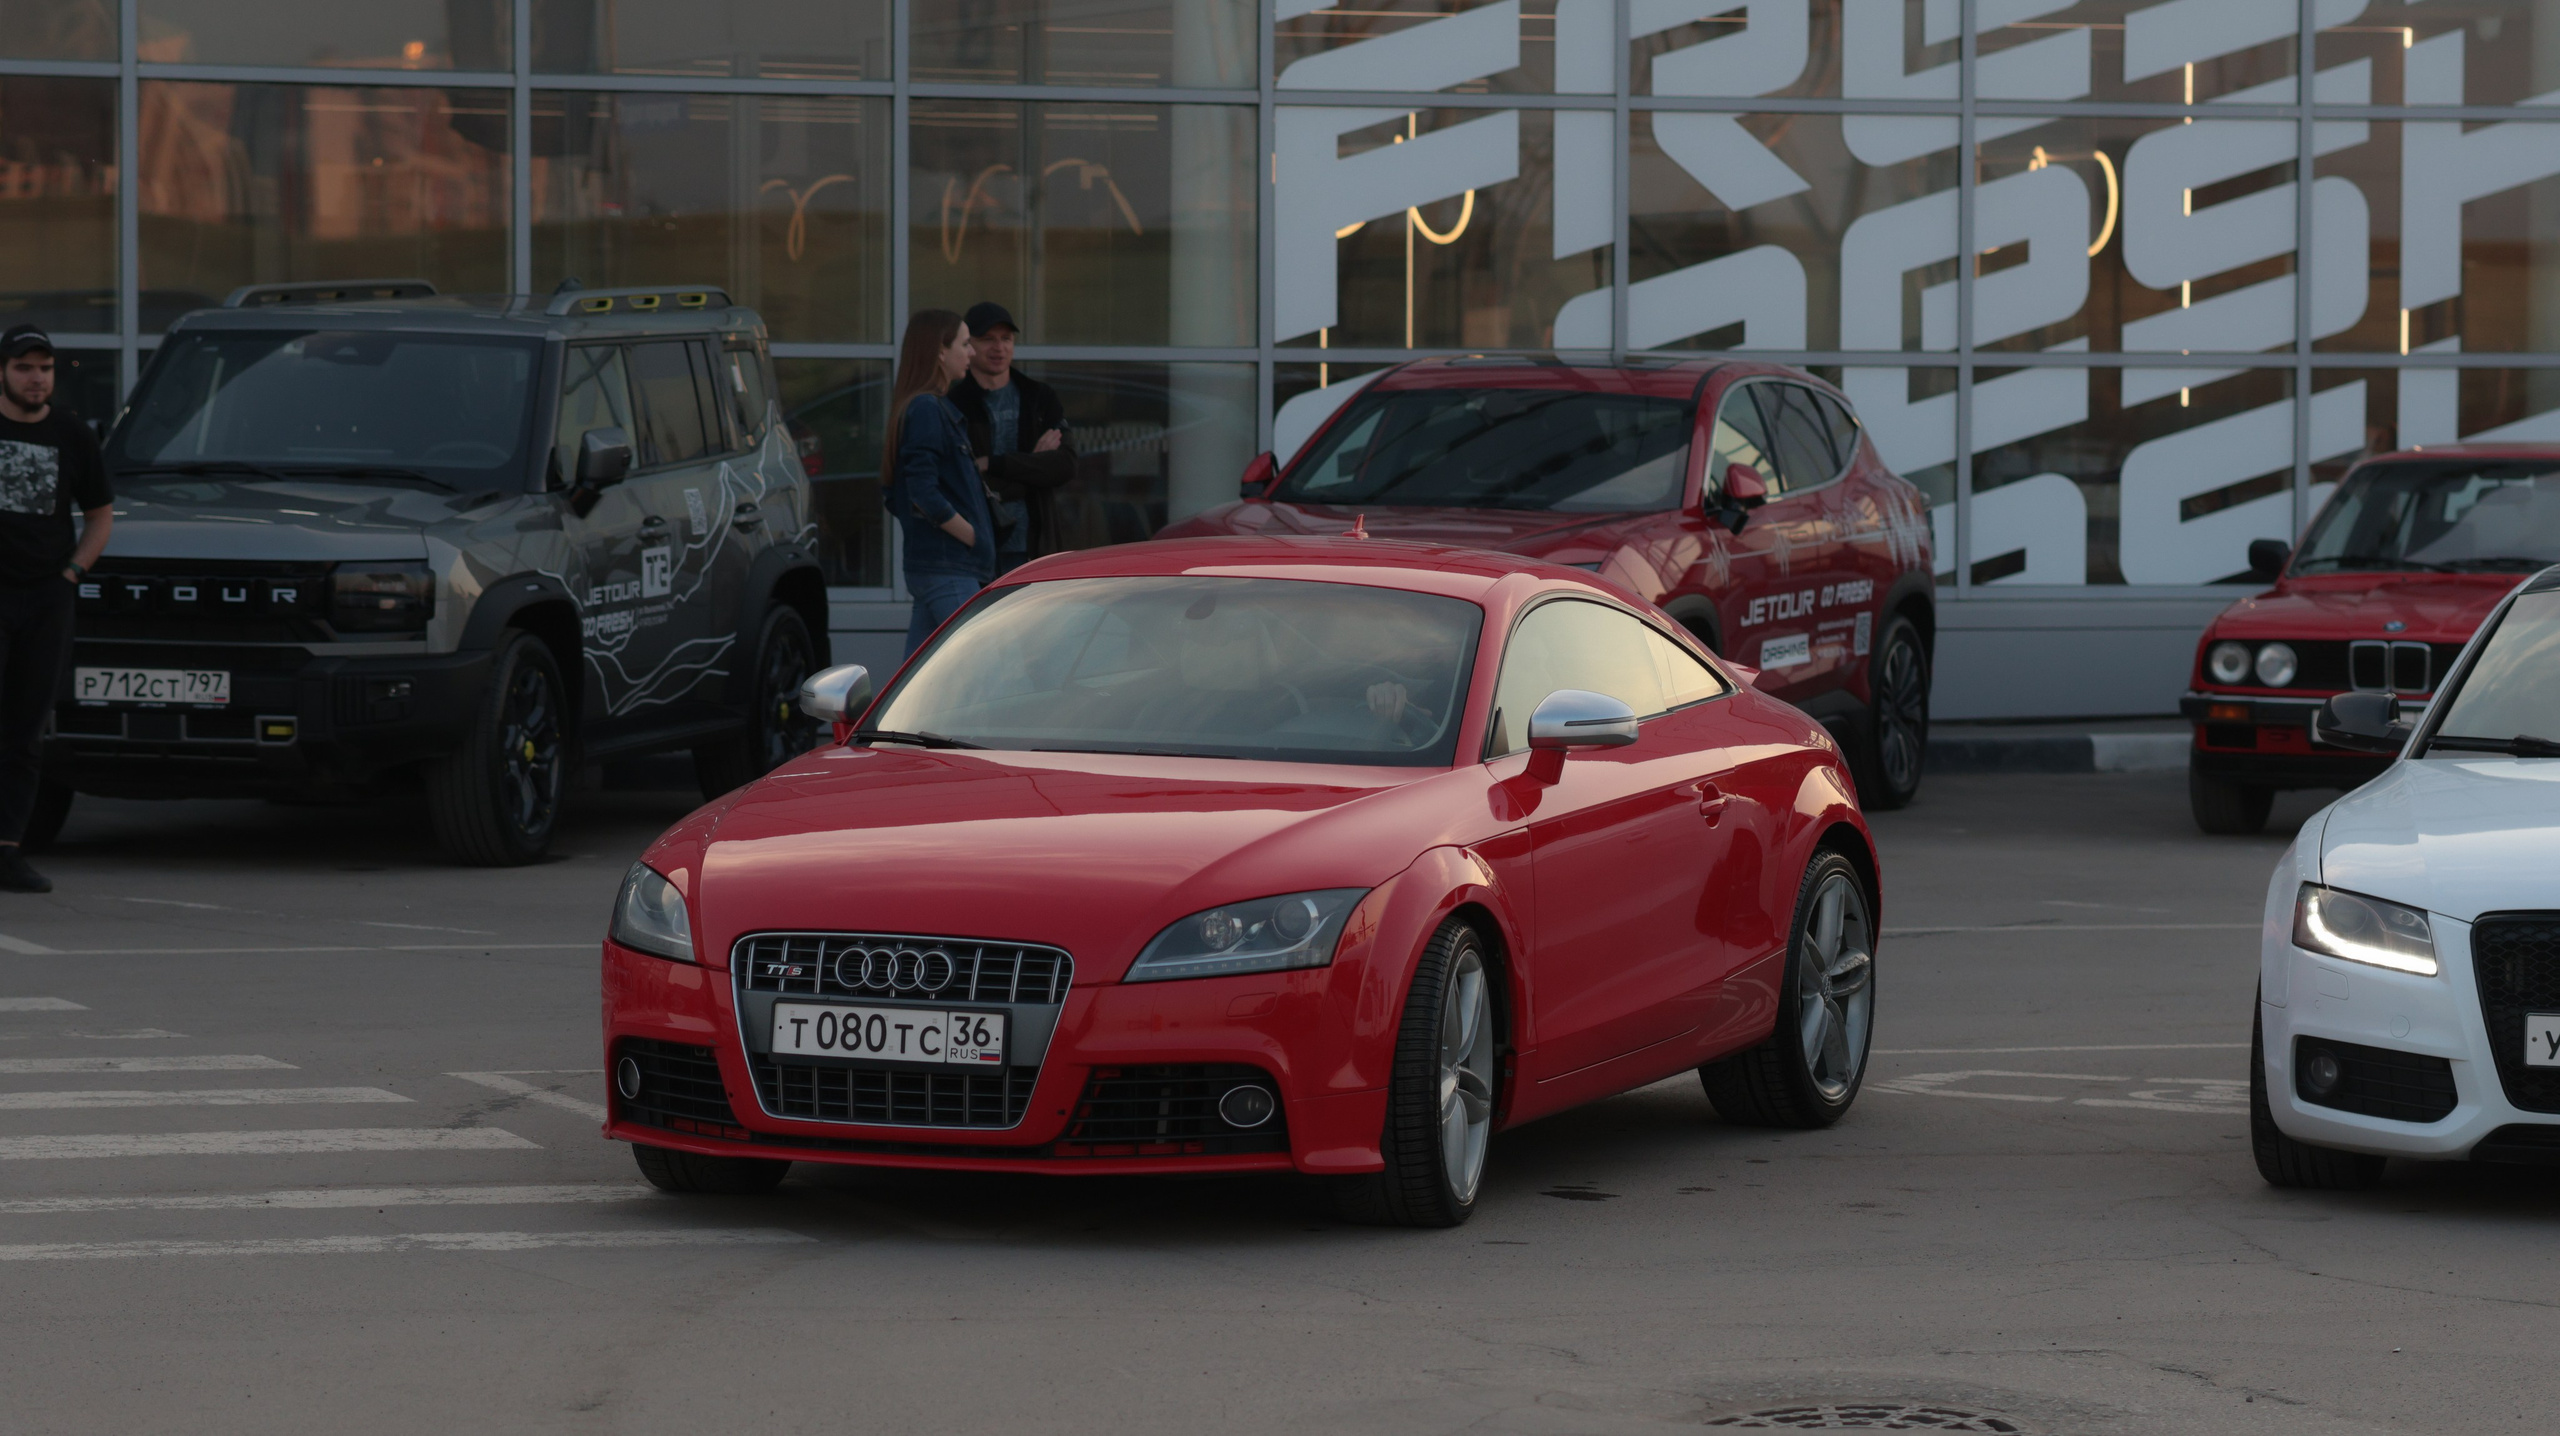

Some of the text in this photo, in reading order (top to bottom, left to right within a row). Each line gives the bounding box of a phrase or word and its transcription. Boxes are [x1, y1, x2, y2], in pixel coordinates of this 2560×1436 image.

[77, 583, 298, 604] ETOUR
[583, 580, 641, 607] JETOUR
[1835, 578, 1874, 606] FRESH
[1740, 588, 1816, 628] JETOUR
[187, 672, 223, 692] 797
[953, 1016, 990, 1047] 36
[950, 1047, 978, 1060] RUS
